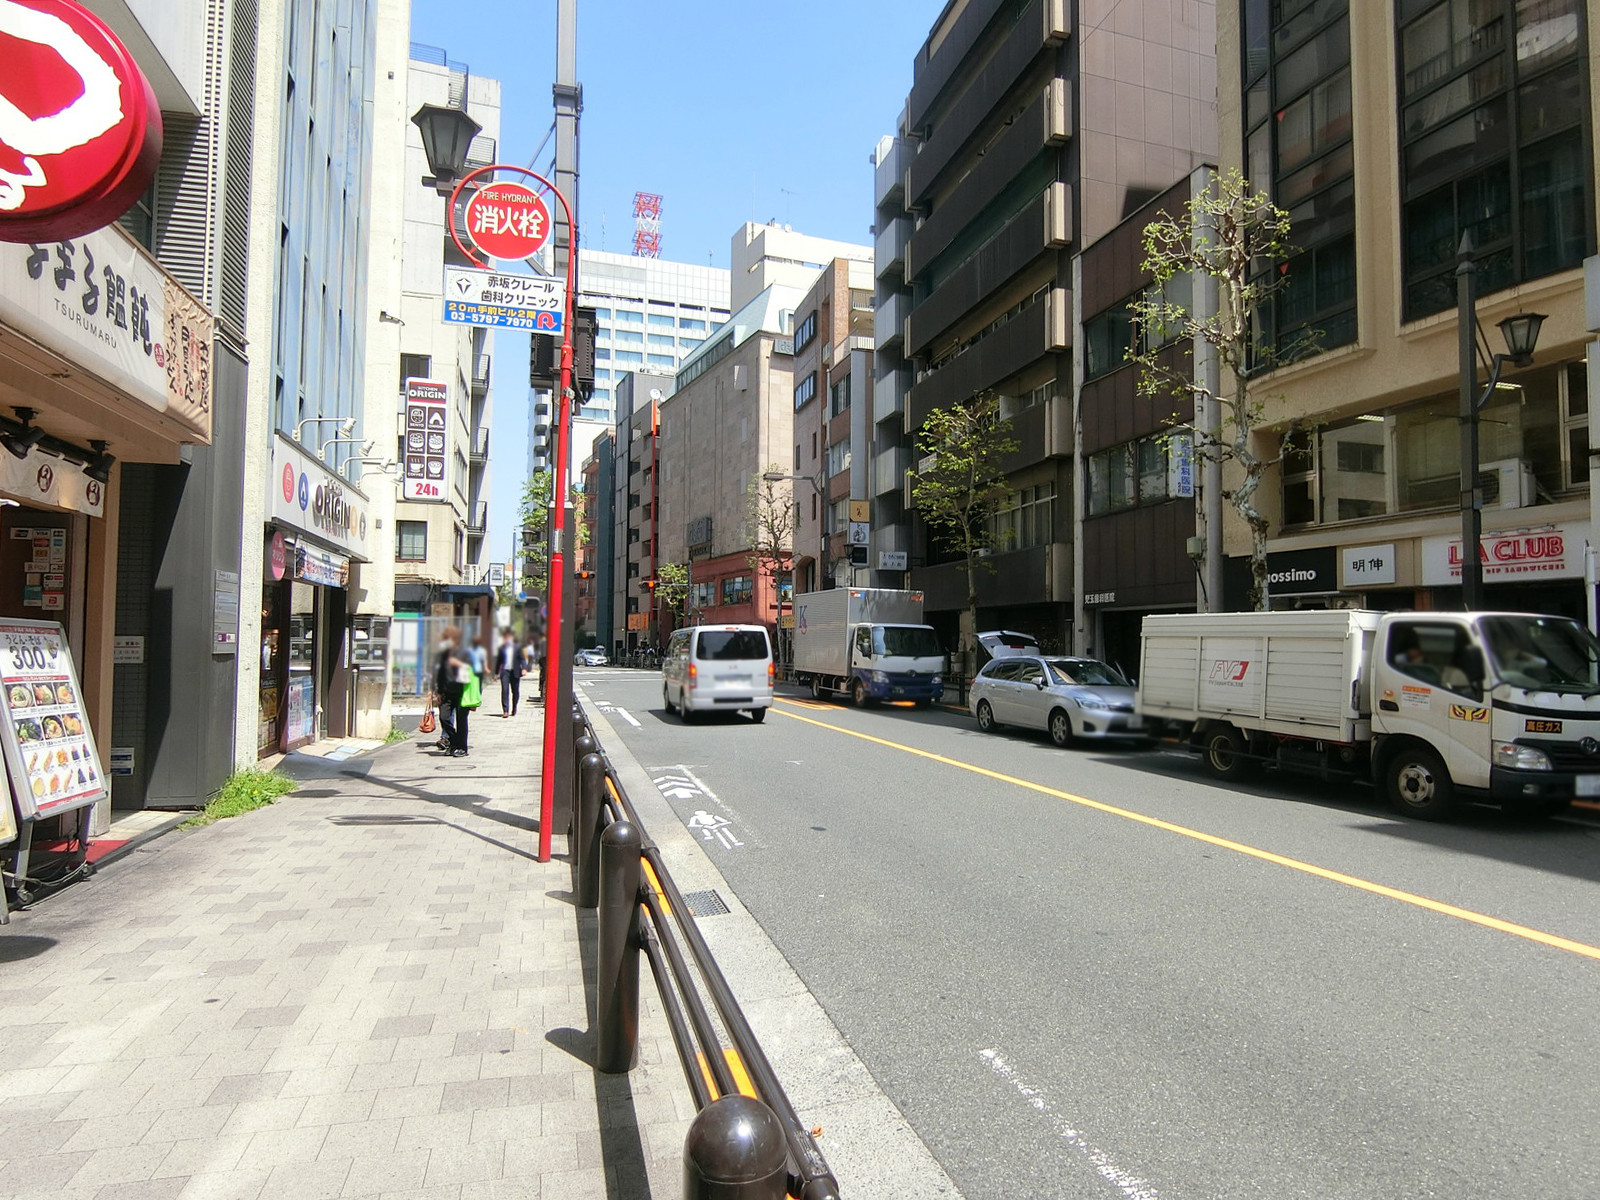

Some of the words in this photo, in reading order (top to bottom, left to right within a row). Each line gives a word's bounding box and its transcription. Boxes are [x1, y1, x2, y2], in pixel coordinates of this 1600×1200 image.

[481, 191, 499, 200] FIRE
[502, 193, 537, 204] HYDRANT
[474, 204, 544, 239] 消火栓
[488, 276, 555, 293] 赤坂クレール
[481, 290, 559, 309] 歯科クリニック
[54, 297, 117, 349] TSURUMARU
[450, 311, 533, 328] 03-5797-7970
[409, 389, 446, 399] ORIGIN
[415, 482, 439, 496] 24h
[315, 484, 351, 530] ORIGIN
[1491, 536, 1565, 561] CLUB
[1352, 558, 1383, 573] 明伸
[1505, 563, 1566, 574] SANDWICHES
[9, 645, 46, 669] 300
[1209, 660, 1250, 680] FVJ
[1526, 721, 1560, 732] 高圧ガス
